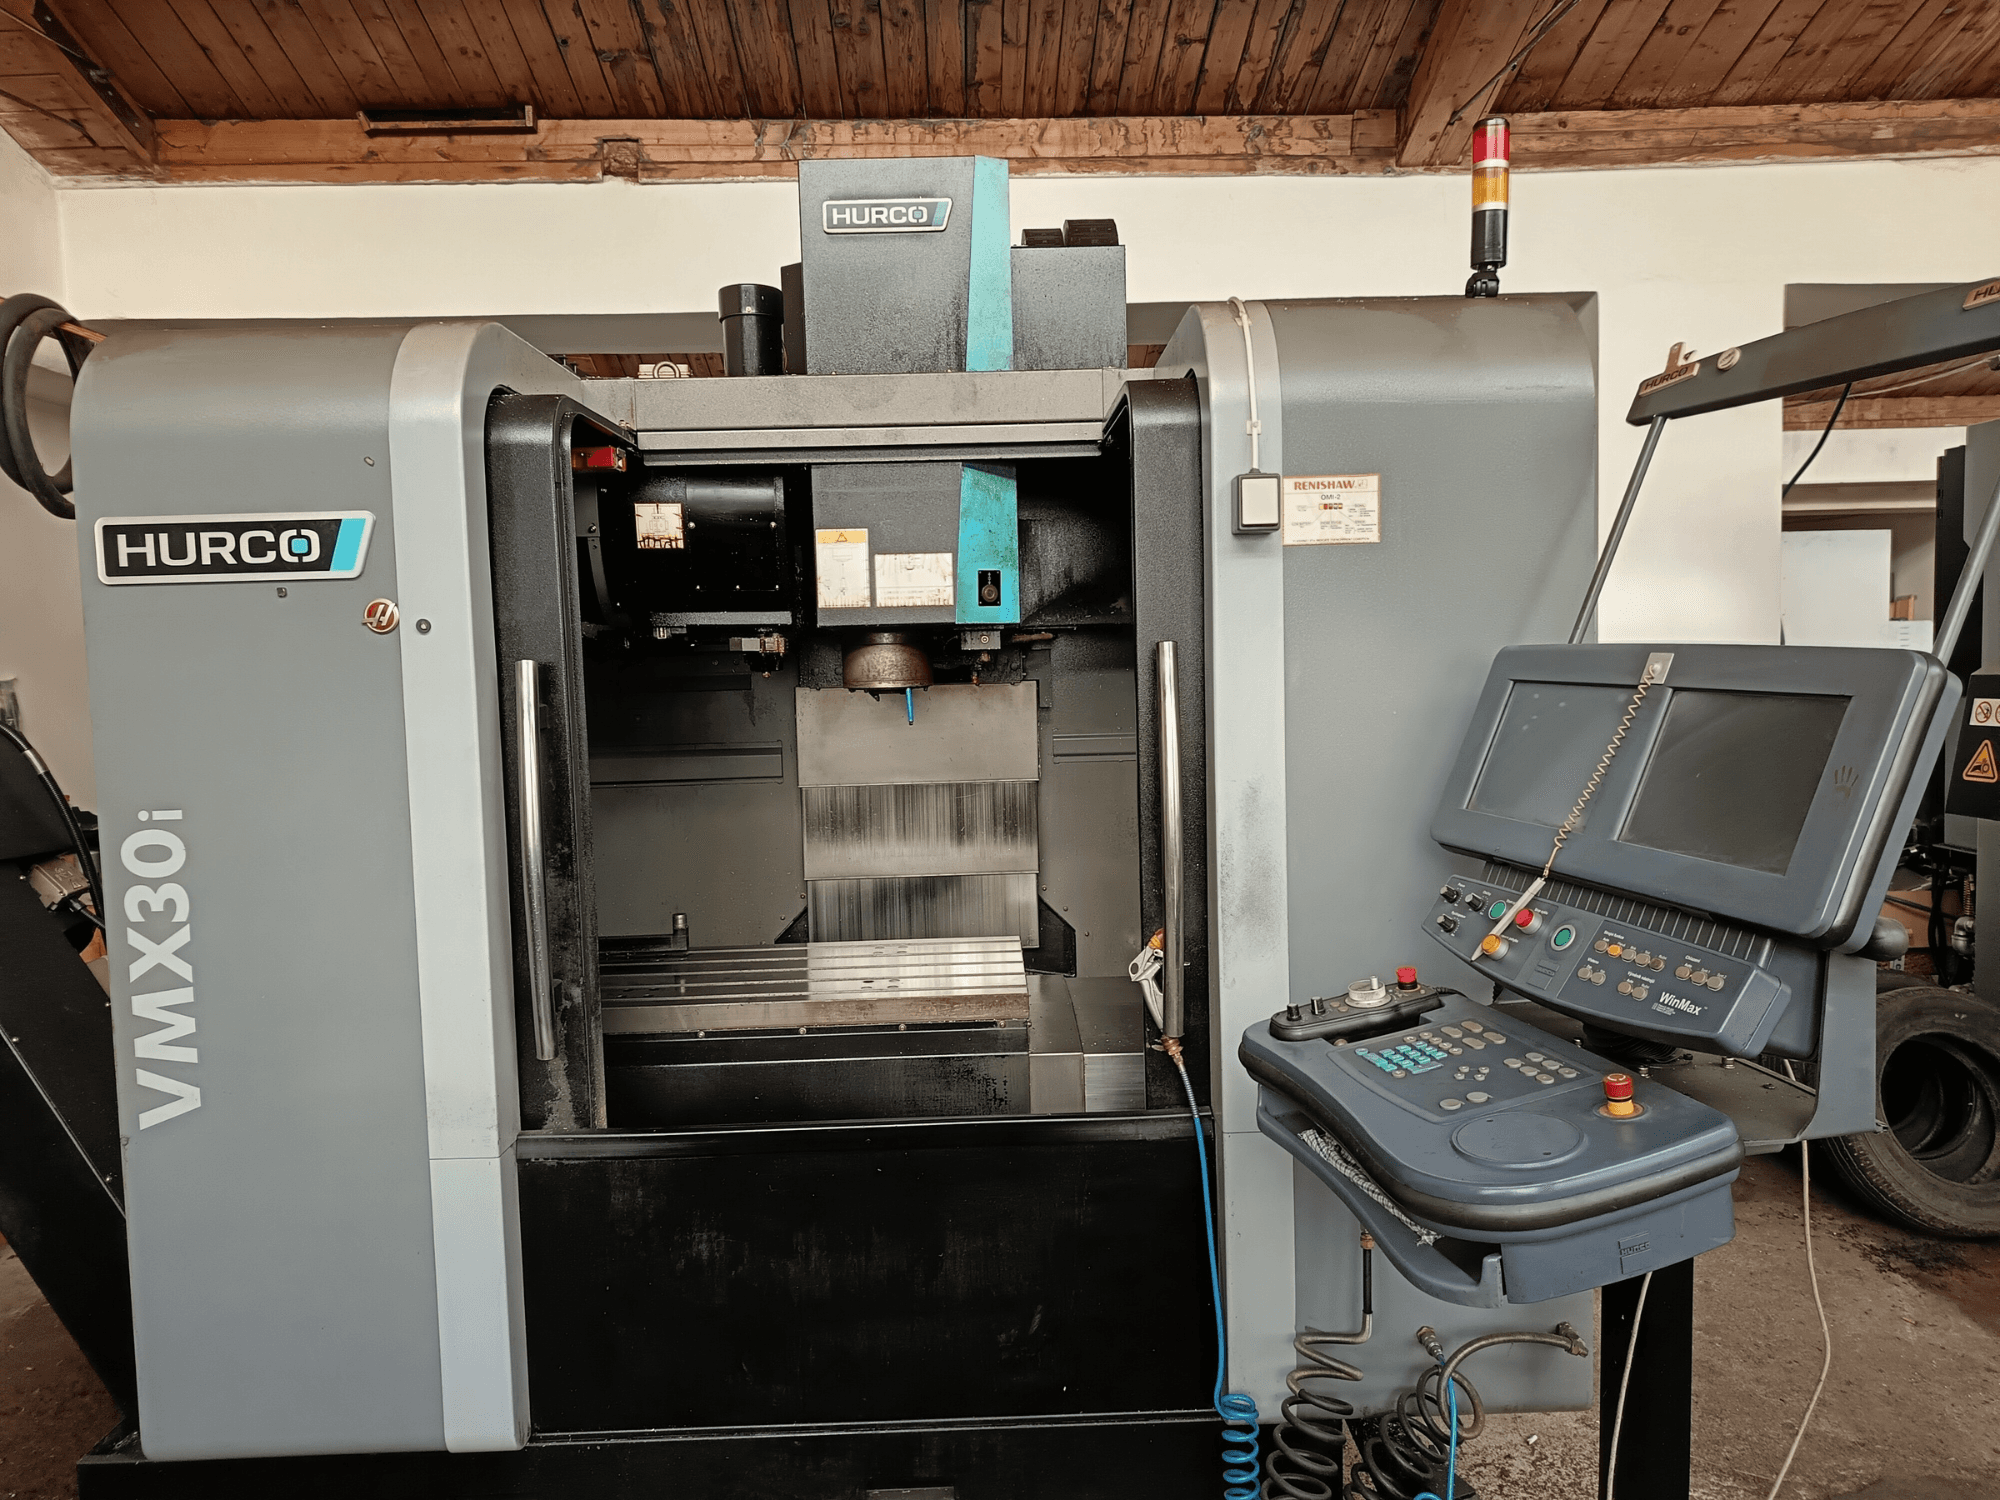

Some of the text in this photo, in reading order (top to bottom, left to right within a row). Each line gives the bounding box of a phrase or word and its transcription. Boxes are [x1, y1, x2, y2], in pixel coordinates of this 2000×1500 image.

[832, 205, 928, 225] HURCO
[1644, 366, 1689, 391] HURCO
[1294, 480, 1355, 490] RENISHAW
[116, 528, 321, 568] HURCO
[120, 809, 201, 1131] VMX30i
[1659, 991, 1703, 1016] WinMax
